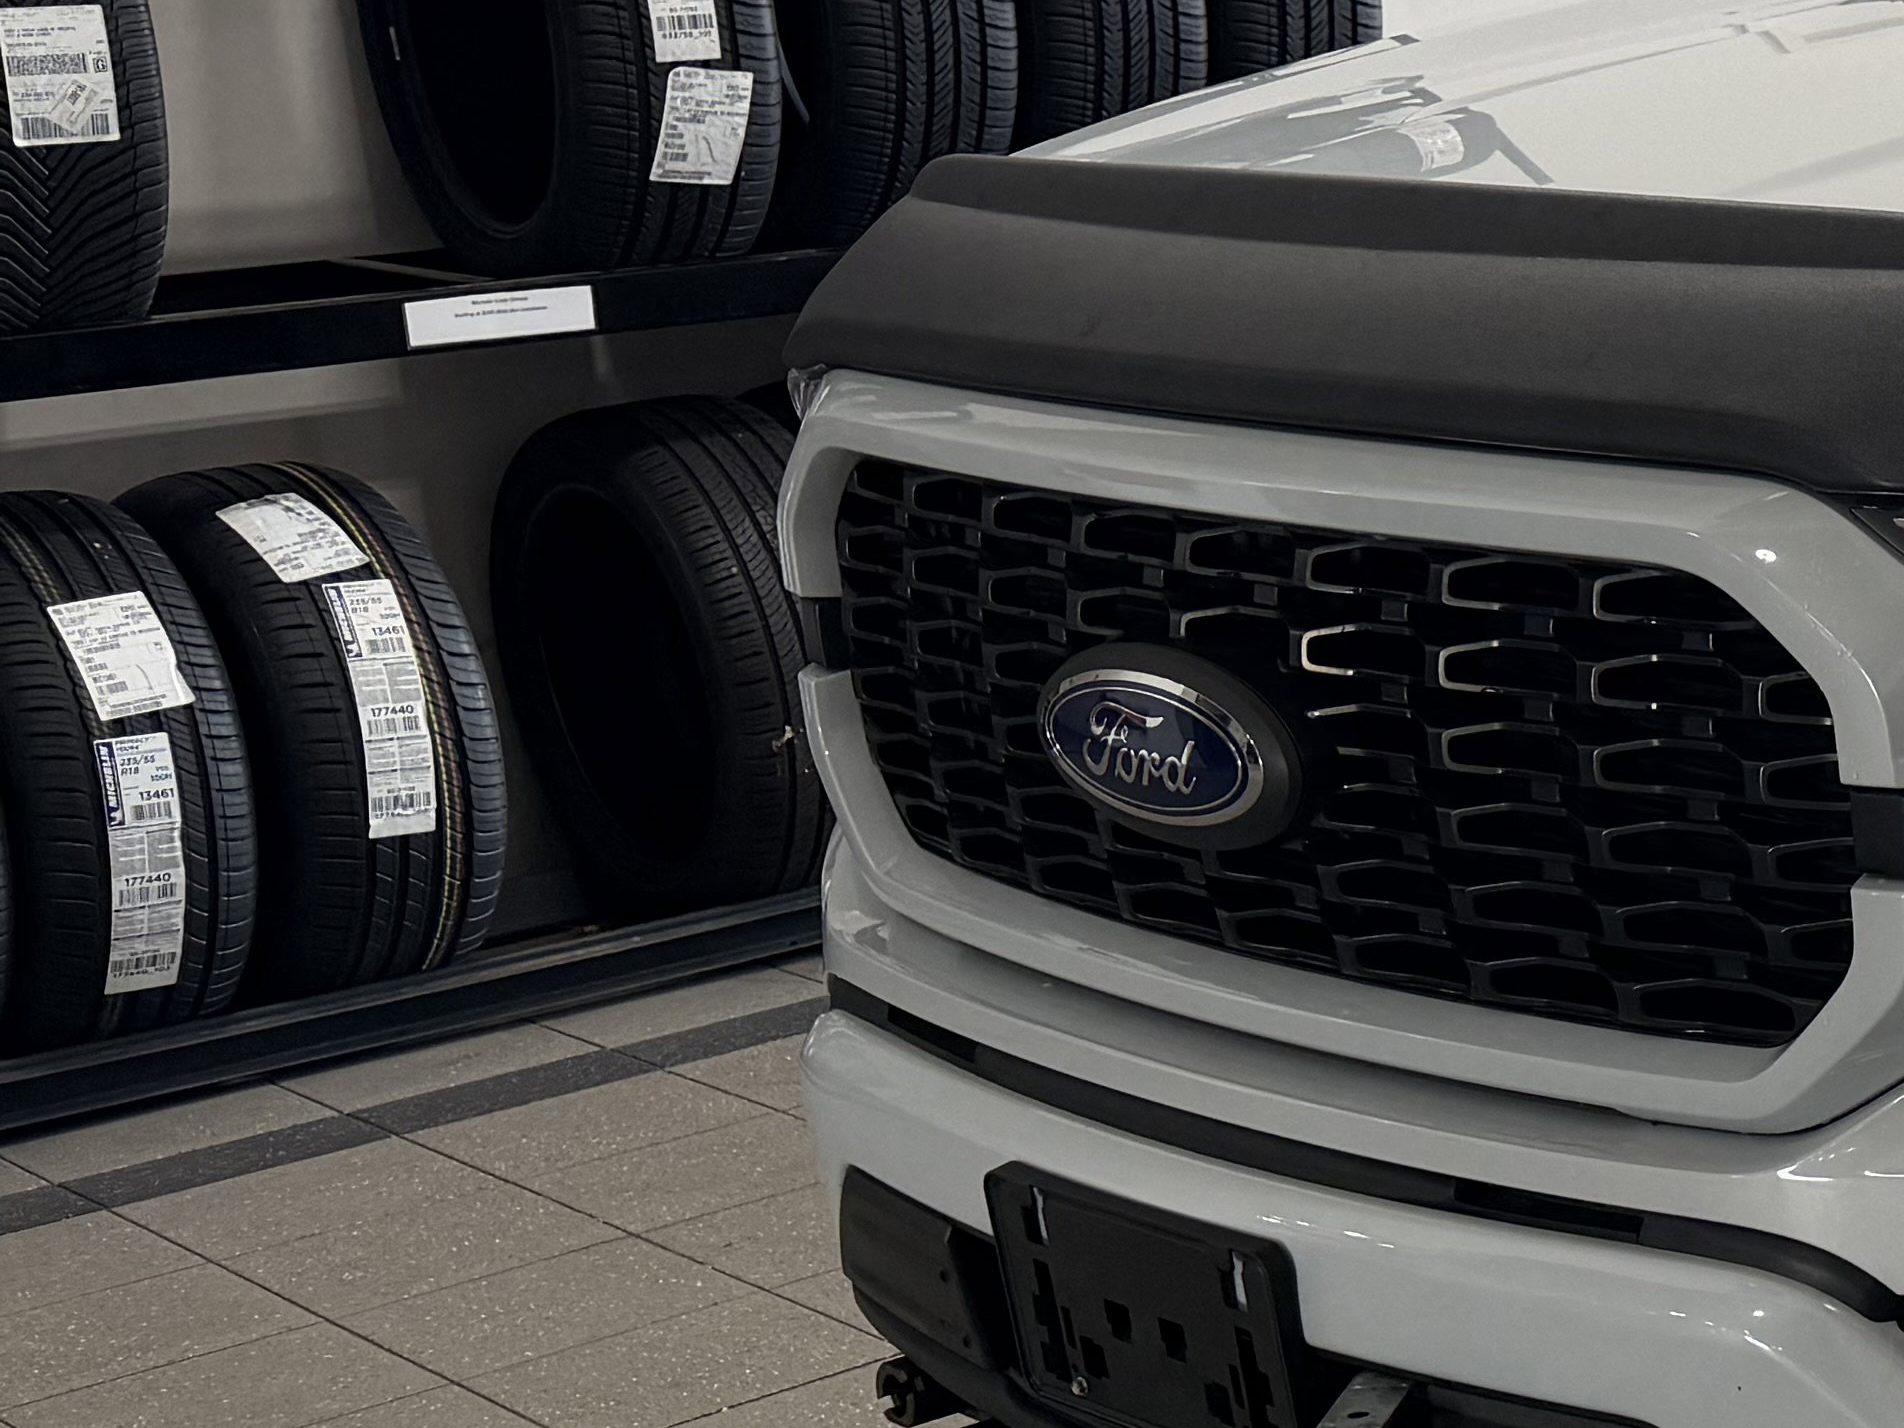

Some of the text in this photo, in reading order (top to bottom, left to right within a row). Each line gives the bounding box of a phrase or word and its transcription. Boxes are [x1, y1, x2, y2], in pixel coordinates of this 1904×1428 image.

[370, 704, 414, 717] 177440
[1082, 701, 1197, 795] Ford
[120, 755, 156, 767] 235/55
[121, 767, 140, 777] R18
[139, 788, 175, 802] 13461
[124, 872, 171, 887] 177440
